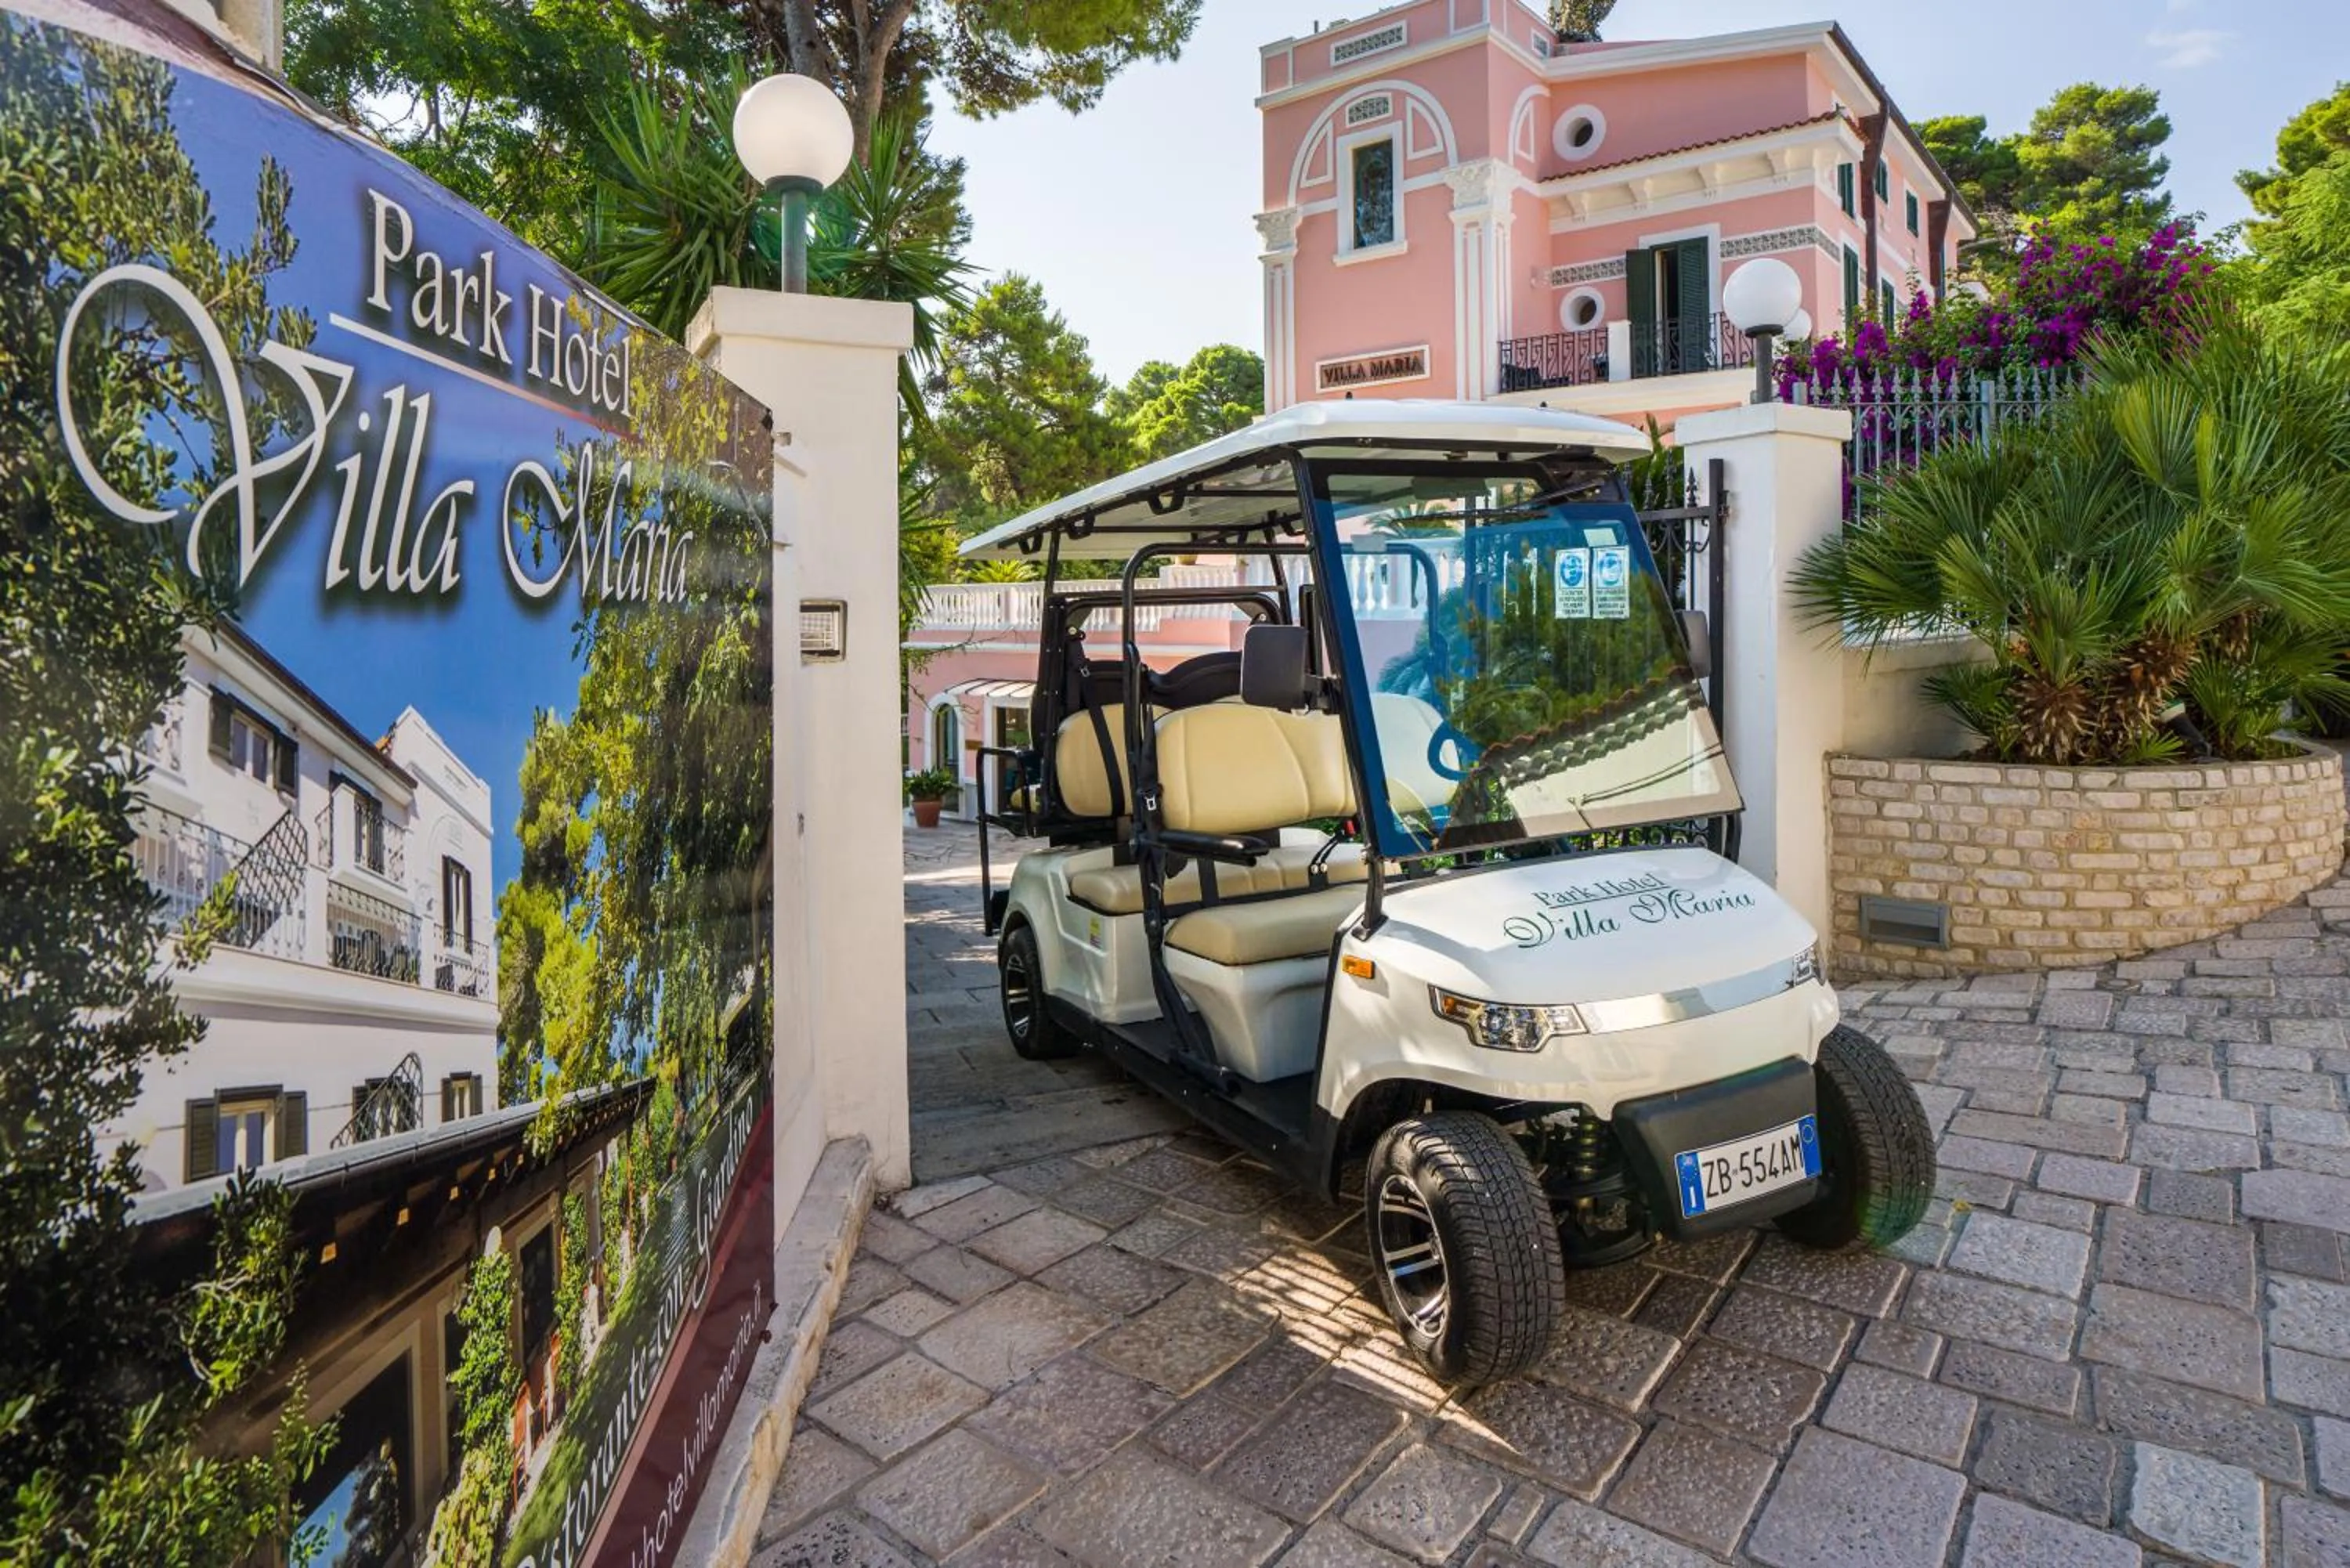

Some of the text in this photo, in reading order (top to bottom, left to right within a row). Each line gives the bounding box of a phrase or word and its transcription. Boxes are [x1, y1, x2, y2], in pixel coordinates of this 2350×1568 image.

[367, 187, 635, 418] Park Hotel
[1323, 355, 1424, 384] VILLA MARIA
[56, 263, 475, 594] Villa
[1503, 889, 1756, 948] Villa Maria
[1531, 873, 1670, 907] Park Hotel
[517, 1096, 753, 1568] storante con Giardino
